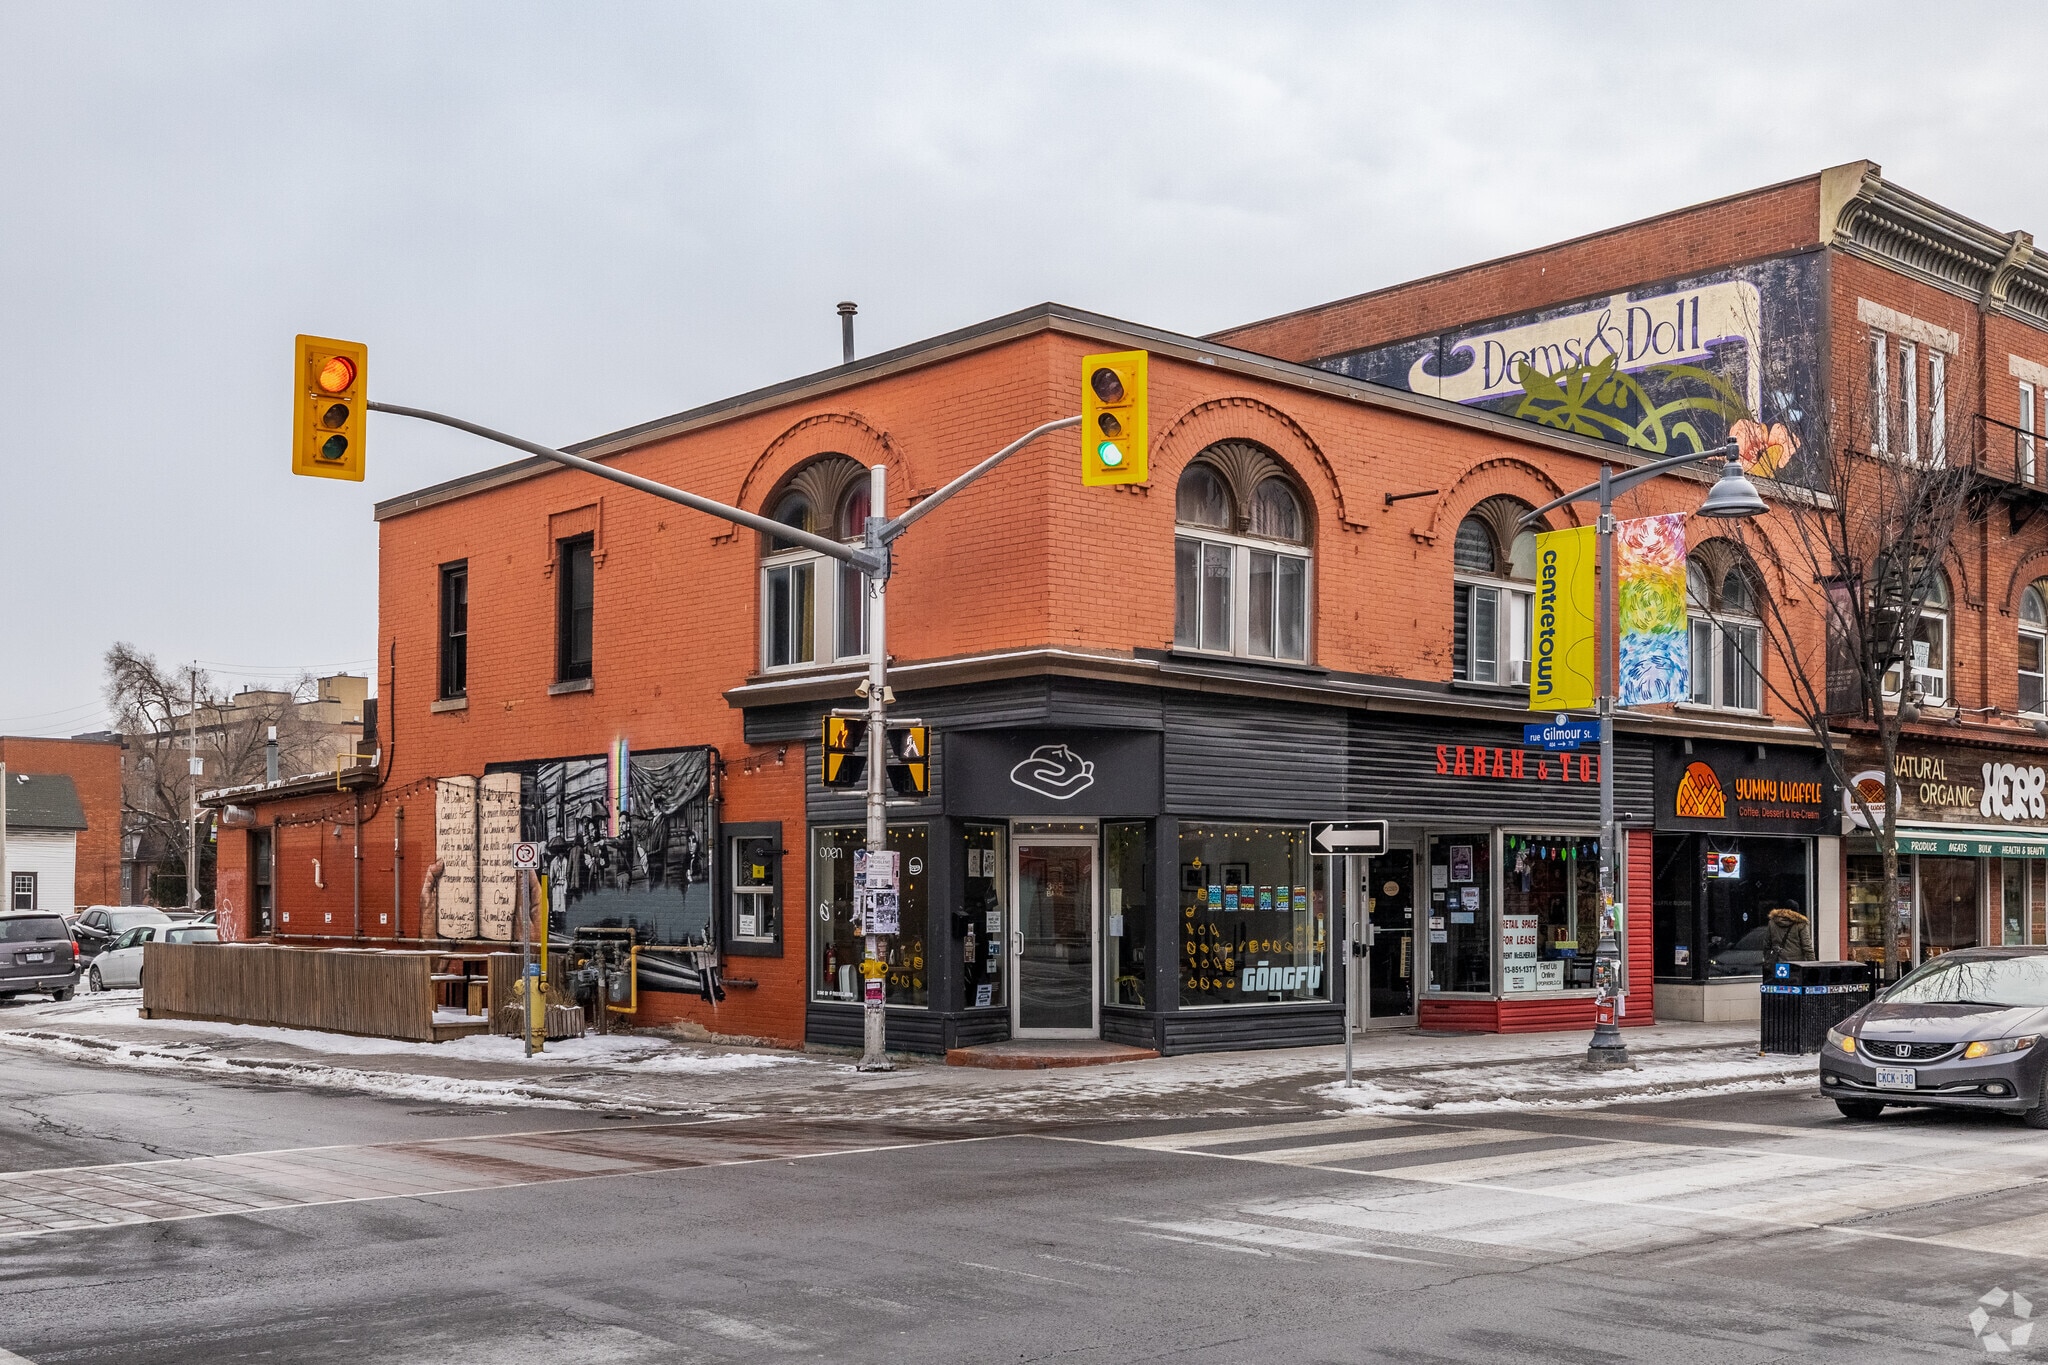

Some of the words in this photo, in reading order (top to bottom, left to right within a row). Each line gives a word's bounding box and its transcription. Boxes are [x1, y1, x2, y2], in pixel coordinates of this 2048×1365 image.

[1625, 296, 1700, 363] Doll
[1537, 549, 1558, 696] centretown
[1529, 734, 1541, 742] rue
[1543, 726, 1581, 741] Gilmour
[1583, 729, 1593, 739] St.
[1436, 743, 1525, 779] SARAH
[1537, 760, 1548, 781] &
[1735, 778, 1777, 802] YUMMY
[1780, 781, 1822, 804] WAFFLE
[1919, 782, 1975, 807] ORGANIC
[1980, 762, 2046, 821] HERB
[1761, 807, 1785, 818] Dessert
[1785, 809, 1790, 818] &
[1790, 809, 1820, 820] Ice-Cream
[819, 846, 843, 862] open
[1910, 841, 1938, 852] PRODUCE
[1948, 843, 1968, 853] MEATS
[1978, 844, 1993, 854] BULK
[2001, 845, 2021, 855] HEALTH
[2021, 846, 2026, 855] &
[1521, 919, 1537, 929] SPACE
[1516, 935, 1536, 945] LEASE
[1503, 965, 1537, 974] 13-851-1377
[1540, 962, 1551, 970] Find
[1551, 962, 1558, 970] Us
[1541, 971, 1556, 979] Online
